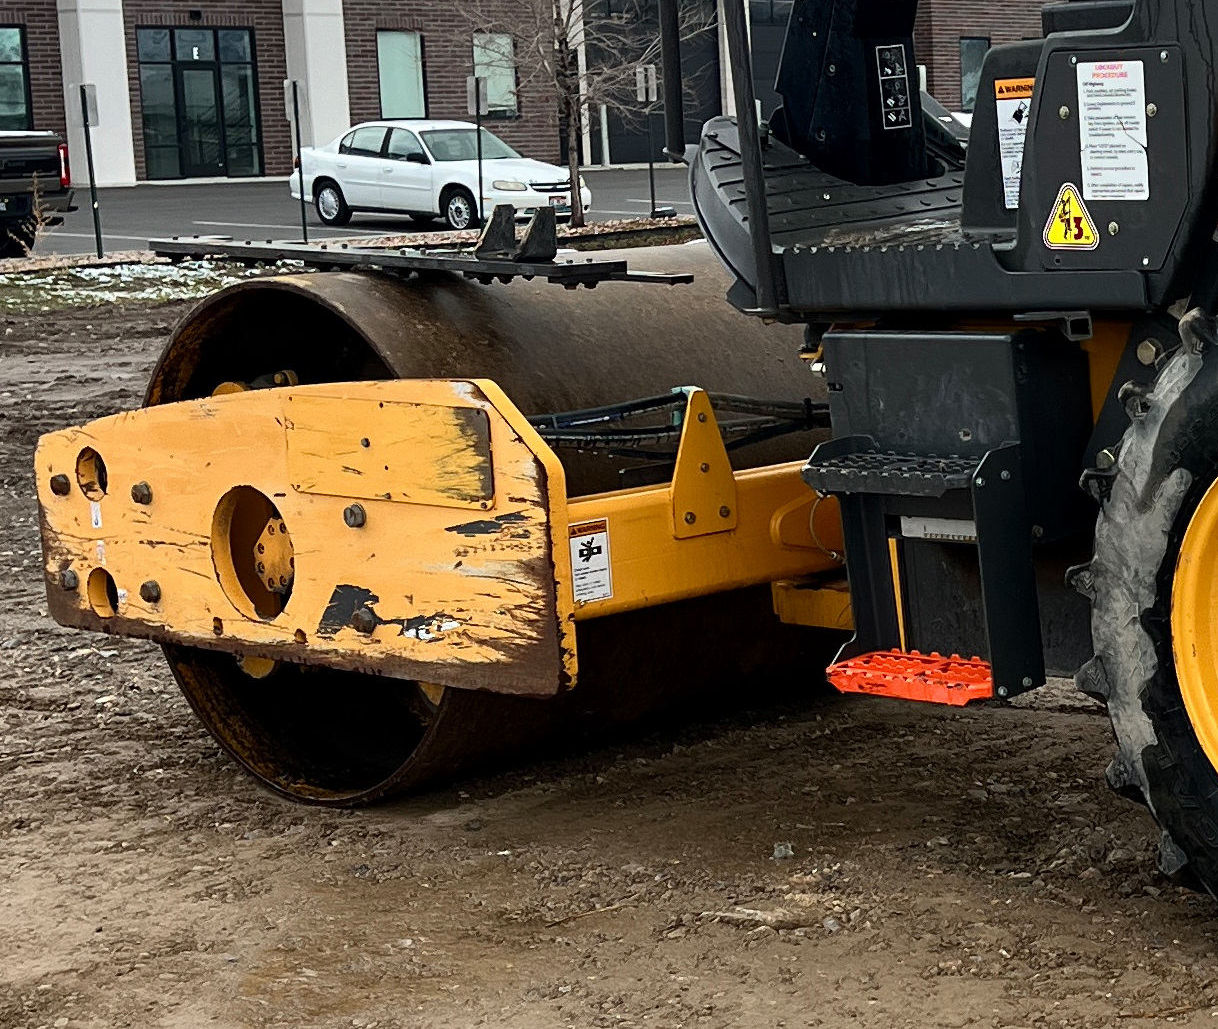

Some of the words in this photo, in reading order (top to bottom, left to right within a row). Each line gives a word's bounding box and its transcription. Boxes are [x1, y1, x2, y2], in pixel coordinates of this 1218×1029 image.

[1095, 63, 1124, 71] LOCKOUT
[1004, 84, 1033, 94] WARNIN
[1073, 216, 1084, 240] 3
[577, 523, 606, 535] WARNING
